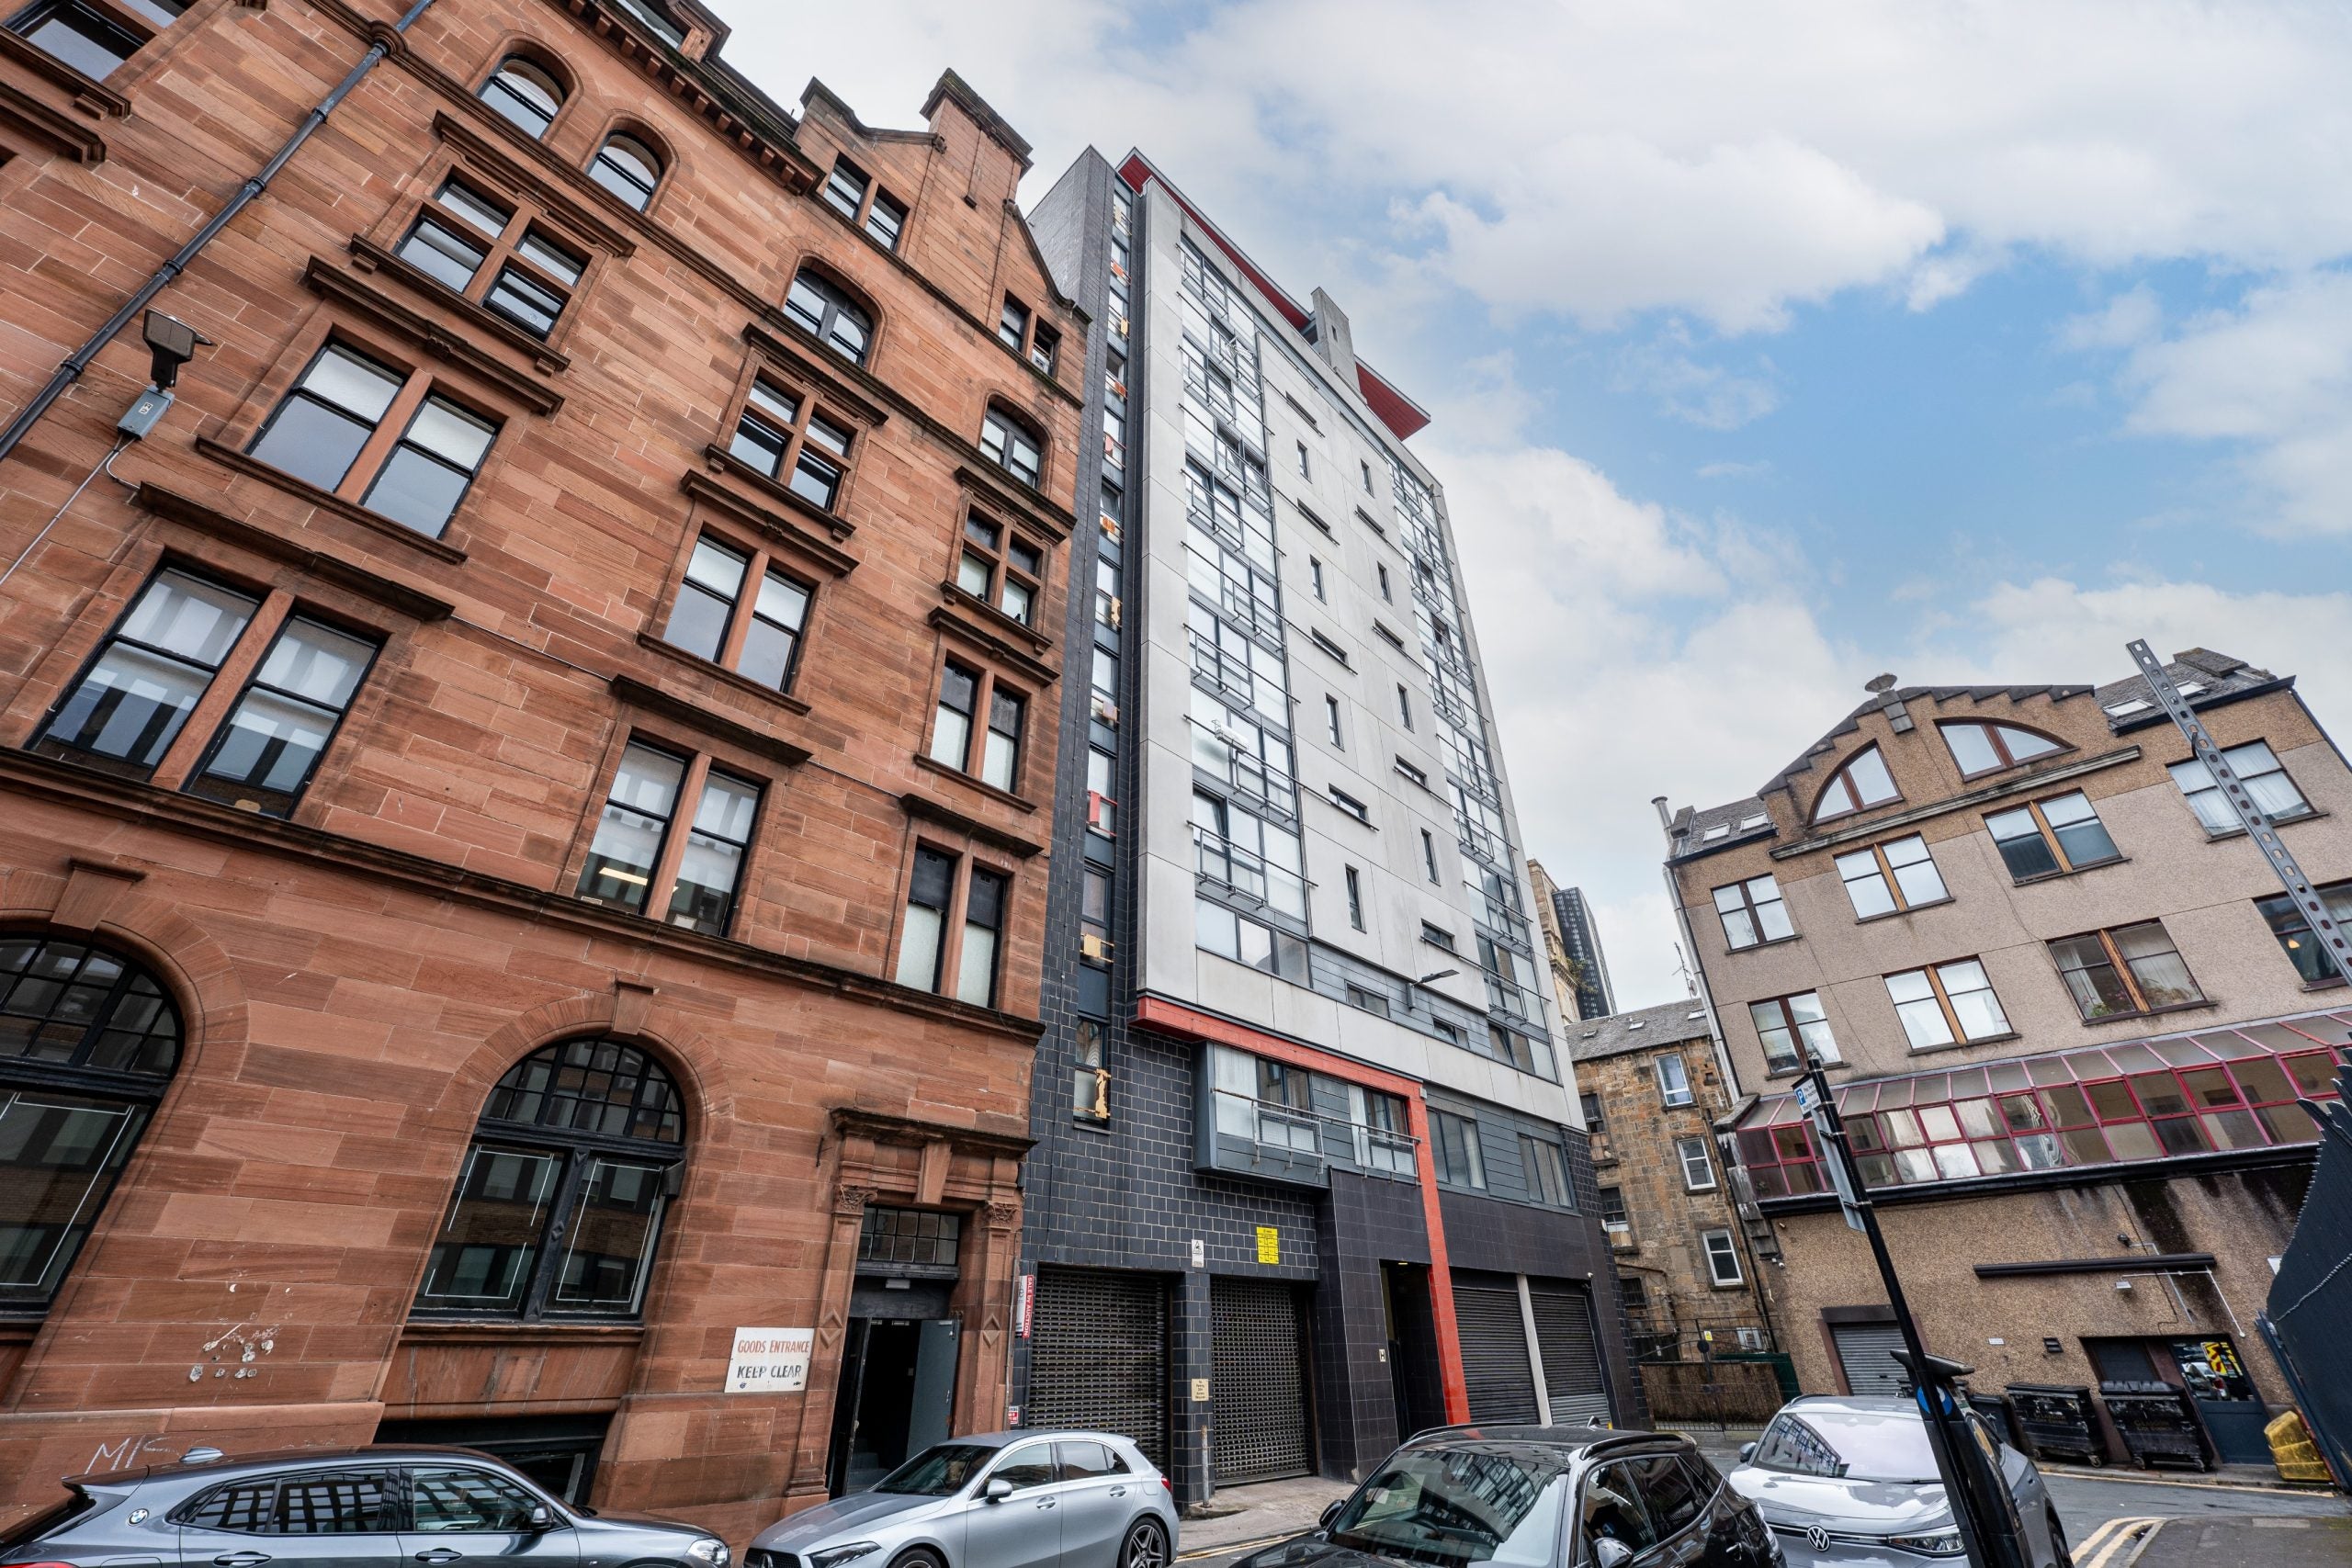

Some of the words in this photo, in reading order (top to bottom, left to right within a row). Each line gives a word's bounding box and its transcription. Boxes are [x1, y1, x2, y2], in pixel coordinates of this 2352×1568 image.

[1797, 1090, 1804, 1103] P
[737, 1340, 766, 1353] GOODS
[769, 1340, 810, 1353] ENTRANCE
[737, 1365, 767, 1379] KEEP
[770, 1365, 802, 1379] CLEAR
